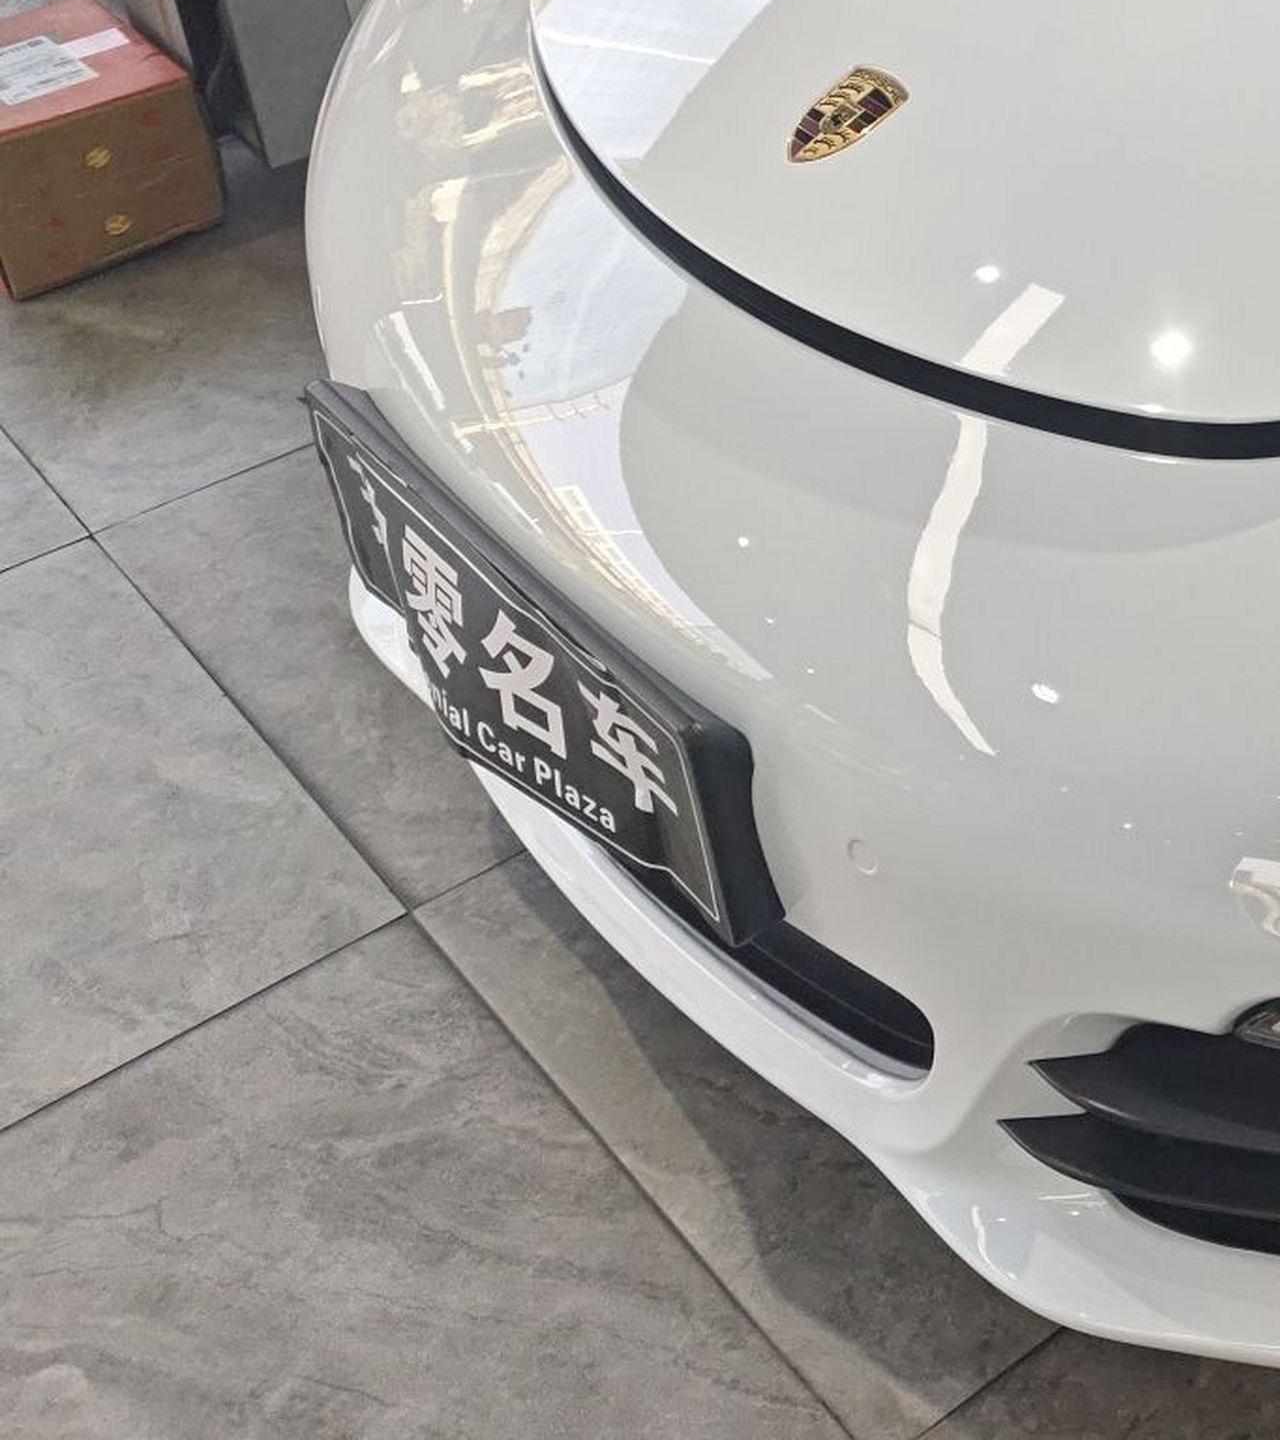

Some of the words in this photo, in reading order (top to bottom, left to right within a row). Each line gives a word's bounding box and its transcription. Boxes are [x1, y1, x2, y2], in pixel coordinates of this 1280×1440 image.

[346, 453, 678, 815] 零名车
[476, 720, 526, 773] Car
[533, 755, 617, 834] Plaza
